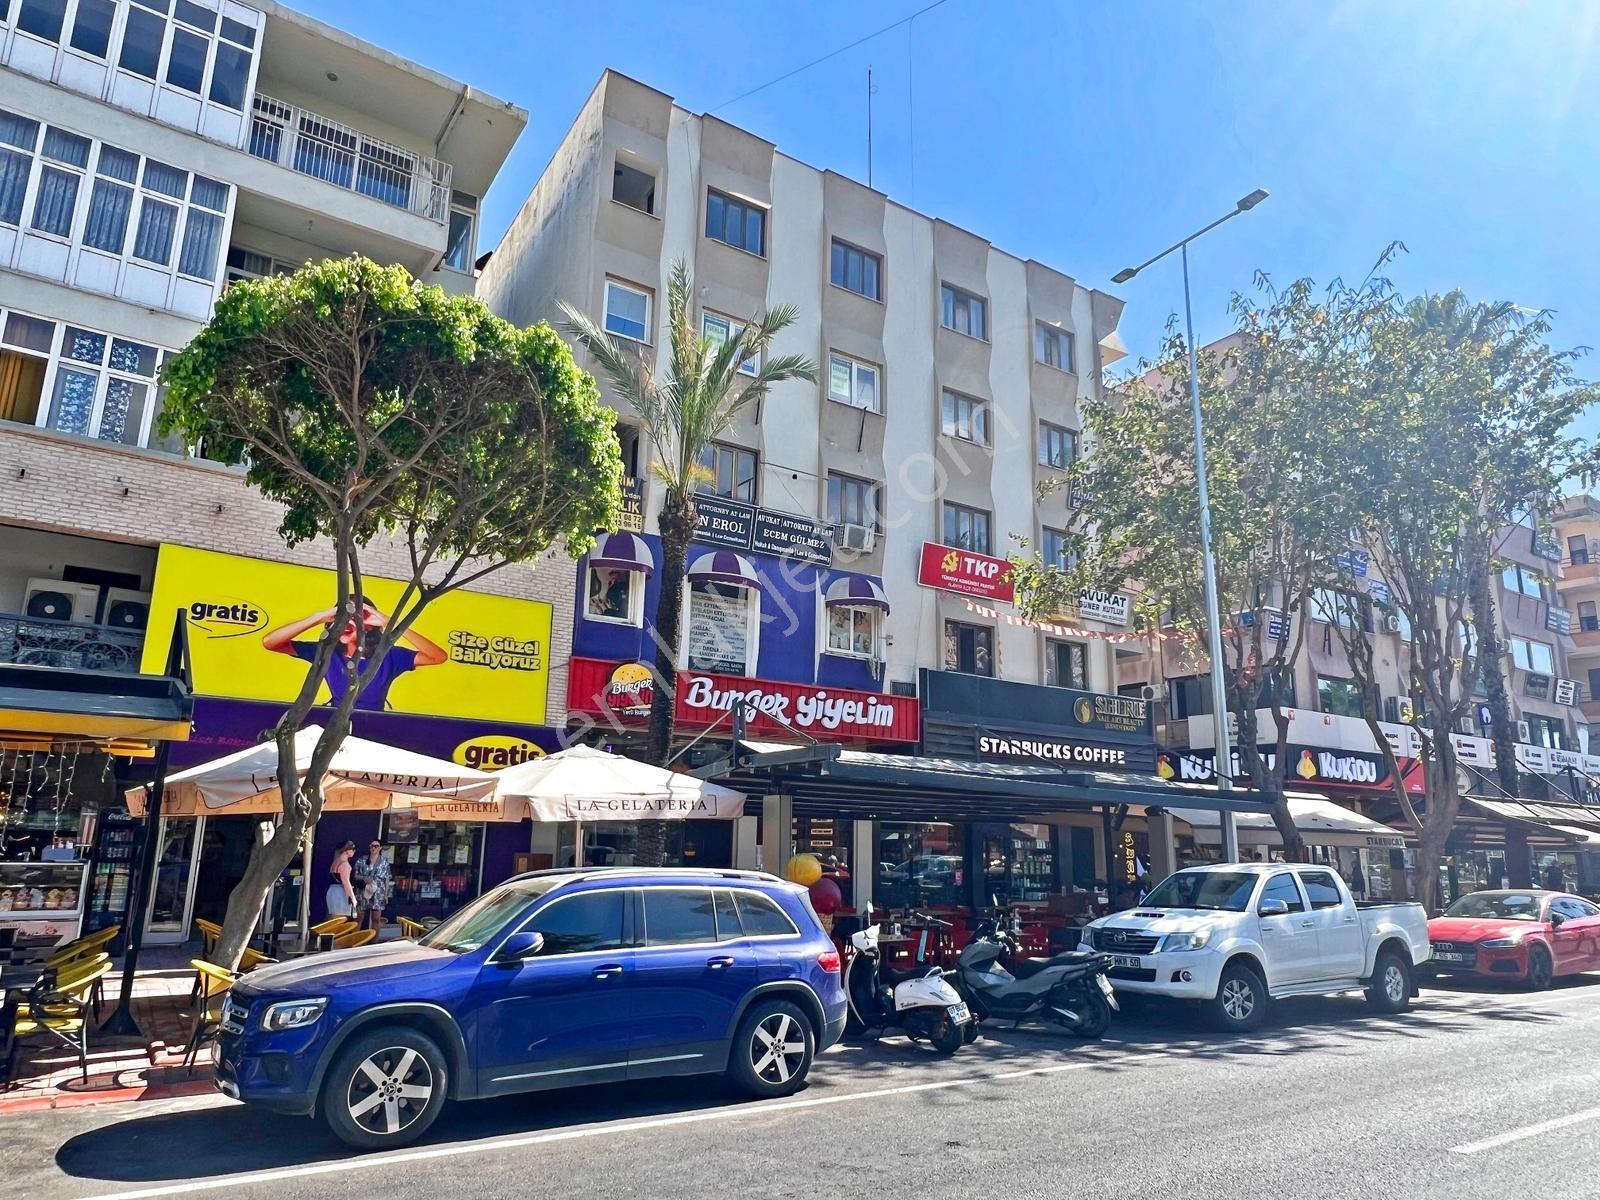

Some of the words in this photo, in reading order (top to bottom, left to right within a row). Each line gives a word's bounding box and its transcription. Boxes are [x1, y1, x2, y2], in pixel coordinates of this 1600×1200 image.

[699, 504, 729, 515] ATTORNEY
[699, 515, 709, 527] N
[712, 517, 746, 534] EROL
[758, 514, 781, 525] AVUKAT
[783, 520, 812, 533] ATTORNEY
[763, 528, 789, 541] ECEM
[964, 557, 999, 579] TKP
[1080, 588, 1127, 608] AVUKAT
[190, 600, 259, 624] gratis
[448, 629, 488, 650] Size
[491, 635, 540, 656] Güzel
[450, 646, 541, 671] Bakıyoruz
[1095, 696, 1147, 718] SHINE
[464, 743, 543, 769] gratis
[980, 736, 1071, 760] STARBUCKS
[1074, 746, 1126, 764] COFFEE
[435, 803, 446, 812] LA
[448, 802, 500, 813] GELATERIA
[577, 799, 600, 811] LA
[608, 799, 708, 812] GELATERIA
